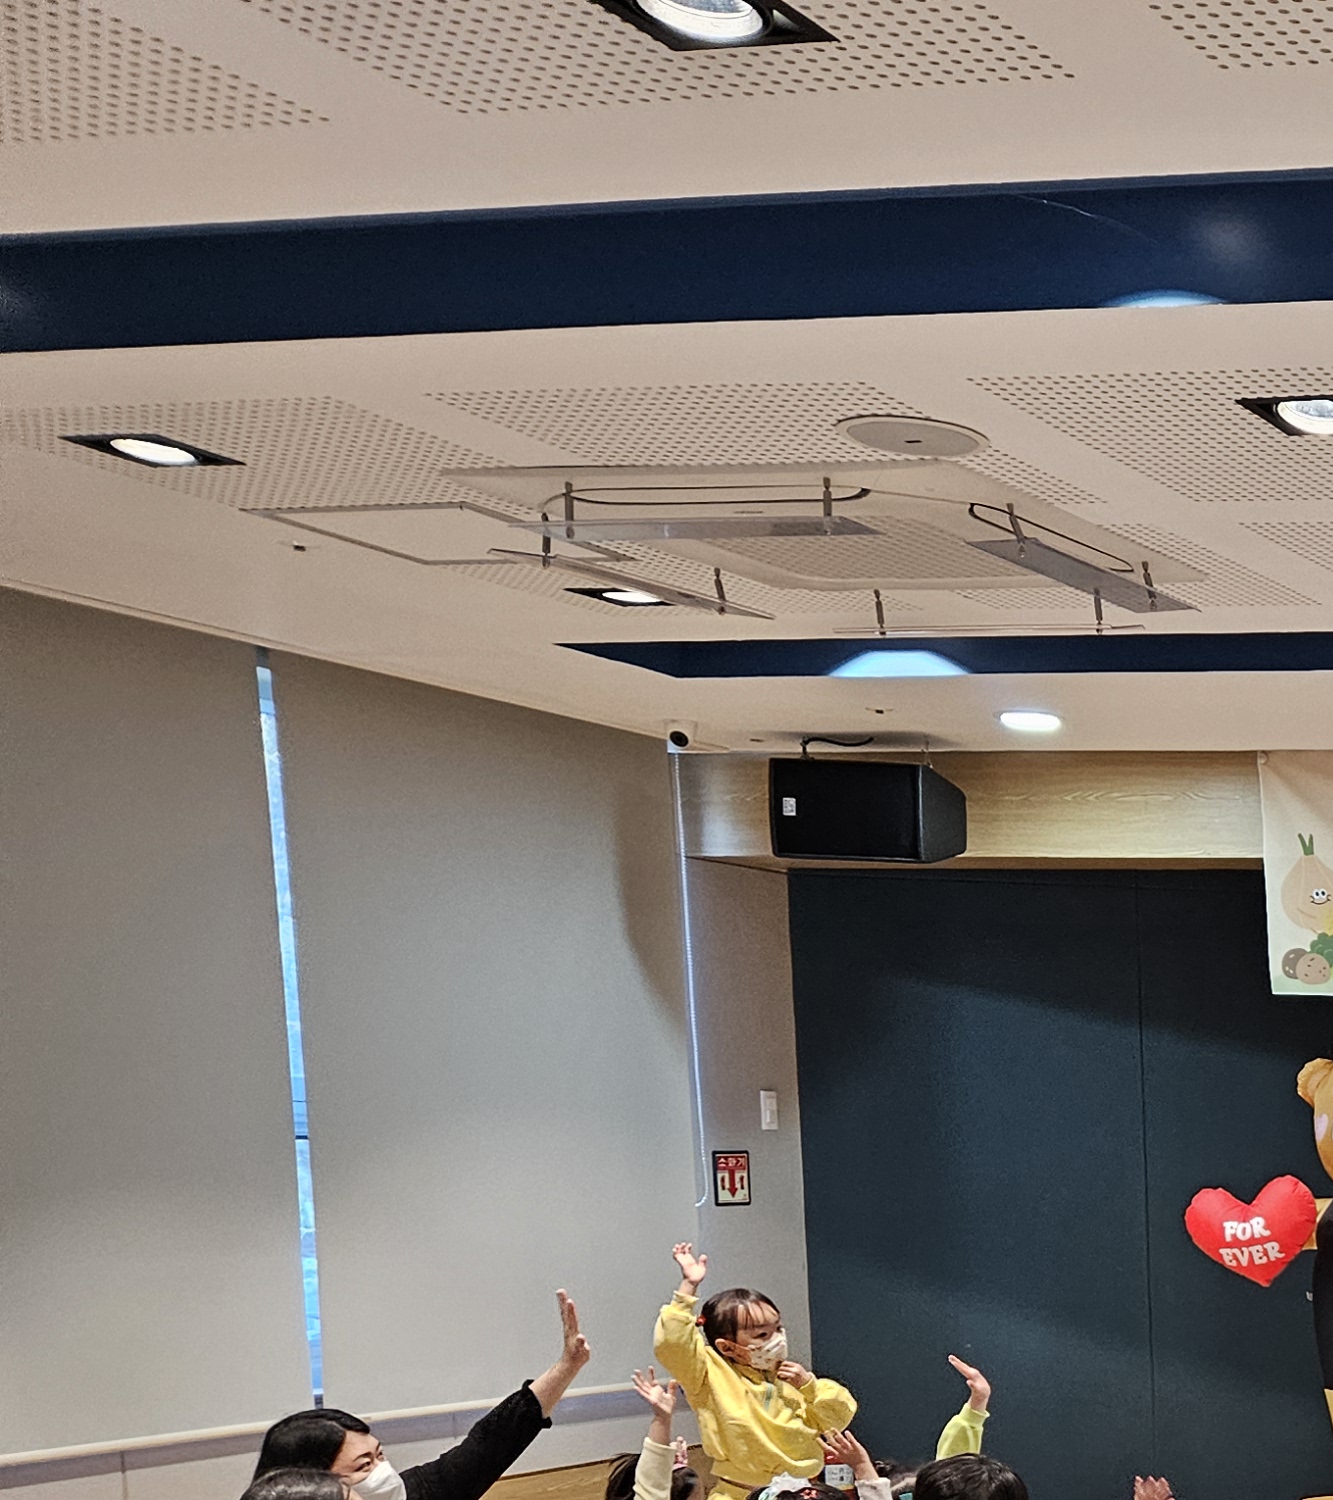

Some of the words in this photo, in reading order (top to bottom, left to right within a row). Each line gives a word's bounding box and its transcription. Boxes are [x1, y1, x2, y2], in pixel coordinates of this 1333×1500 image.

[717, 1156, 746, 1167] 소화기
[1222, 1216, 1272, 1243] FOR
[1218, 1240, 1286, 1267] EVER
